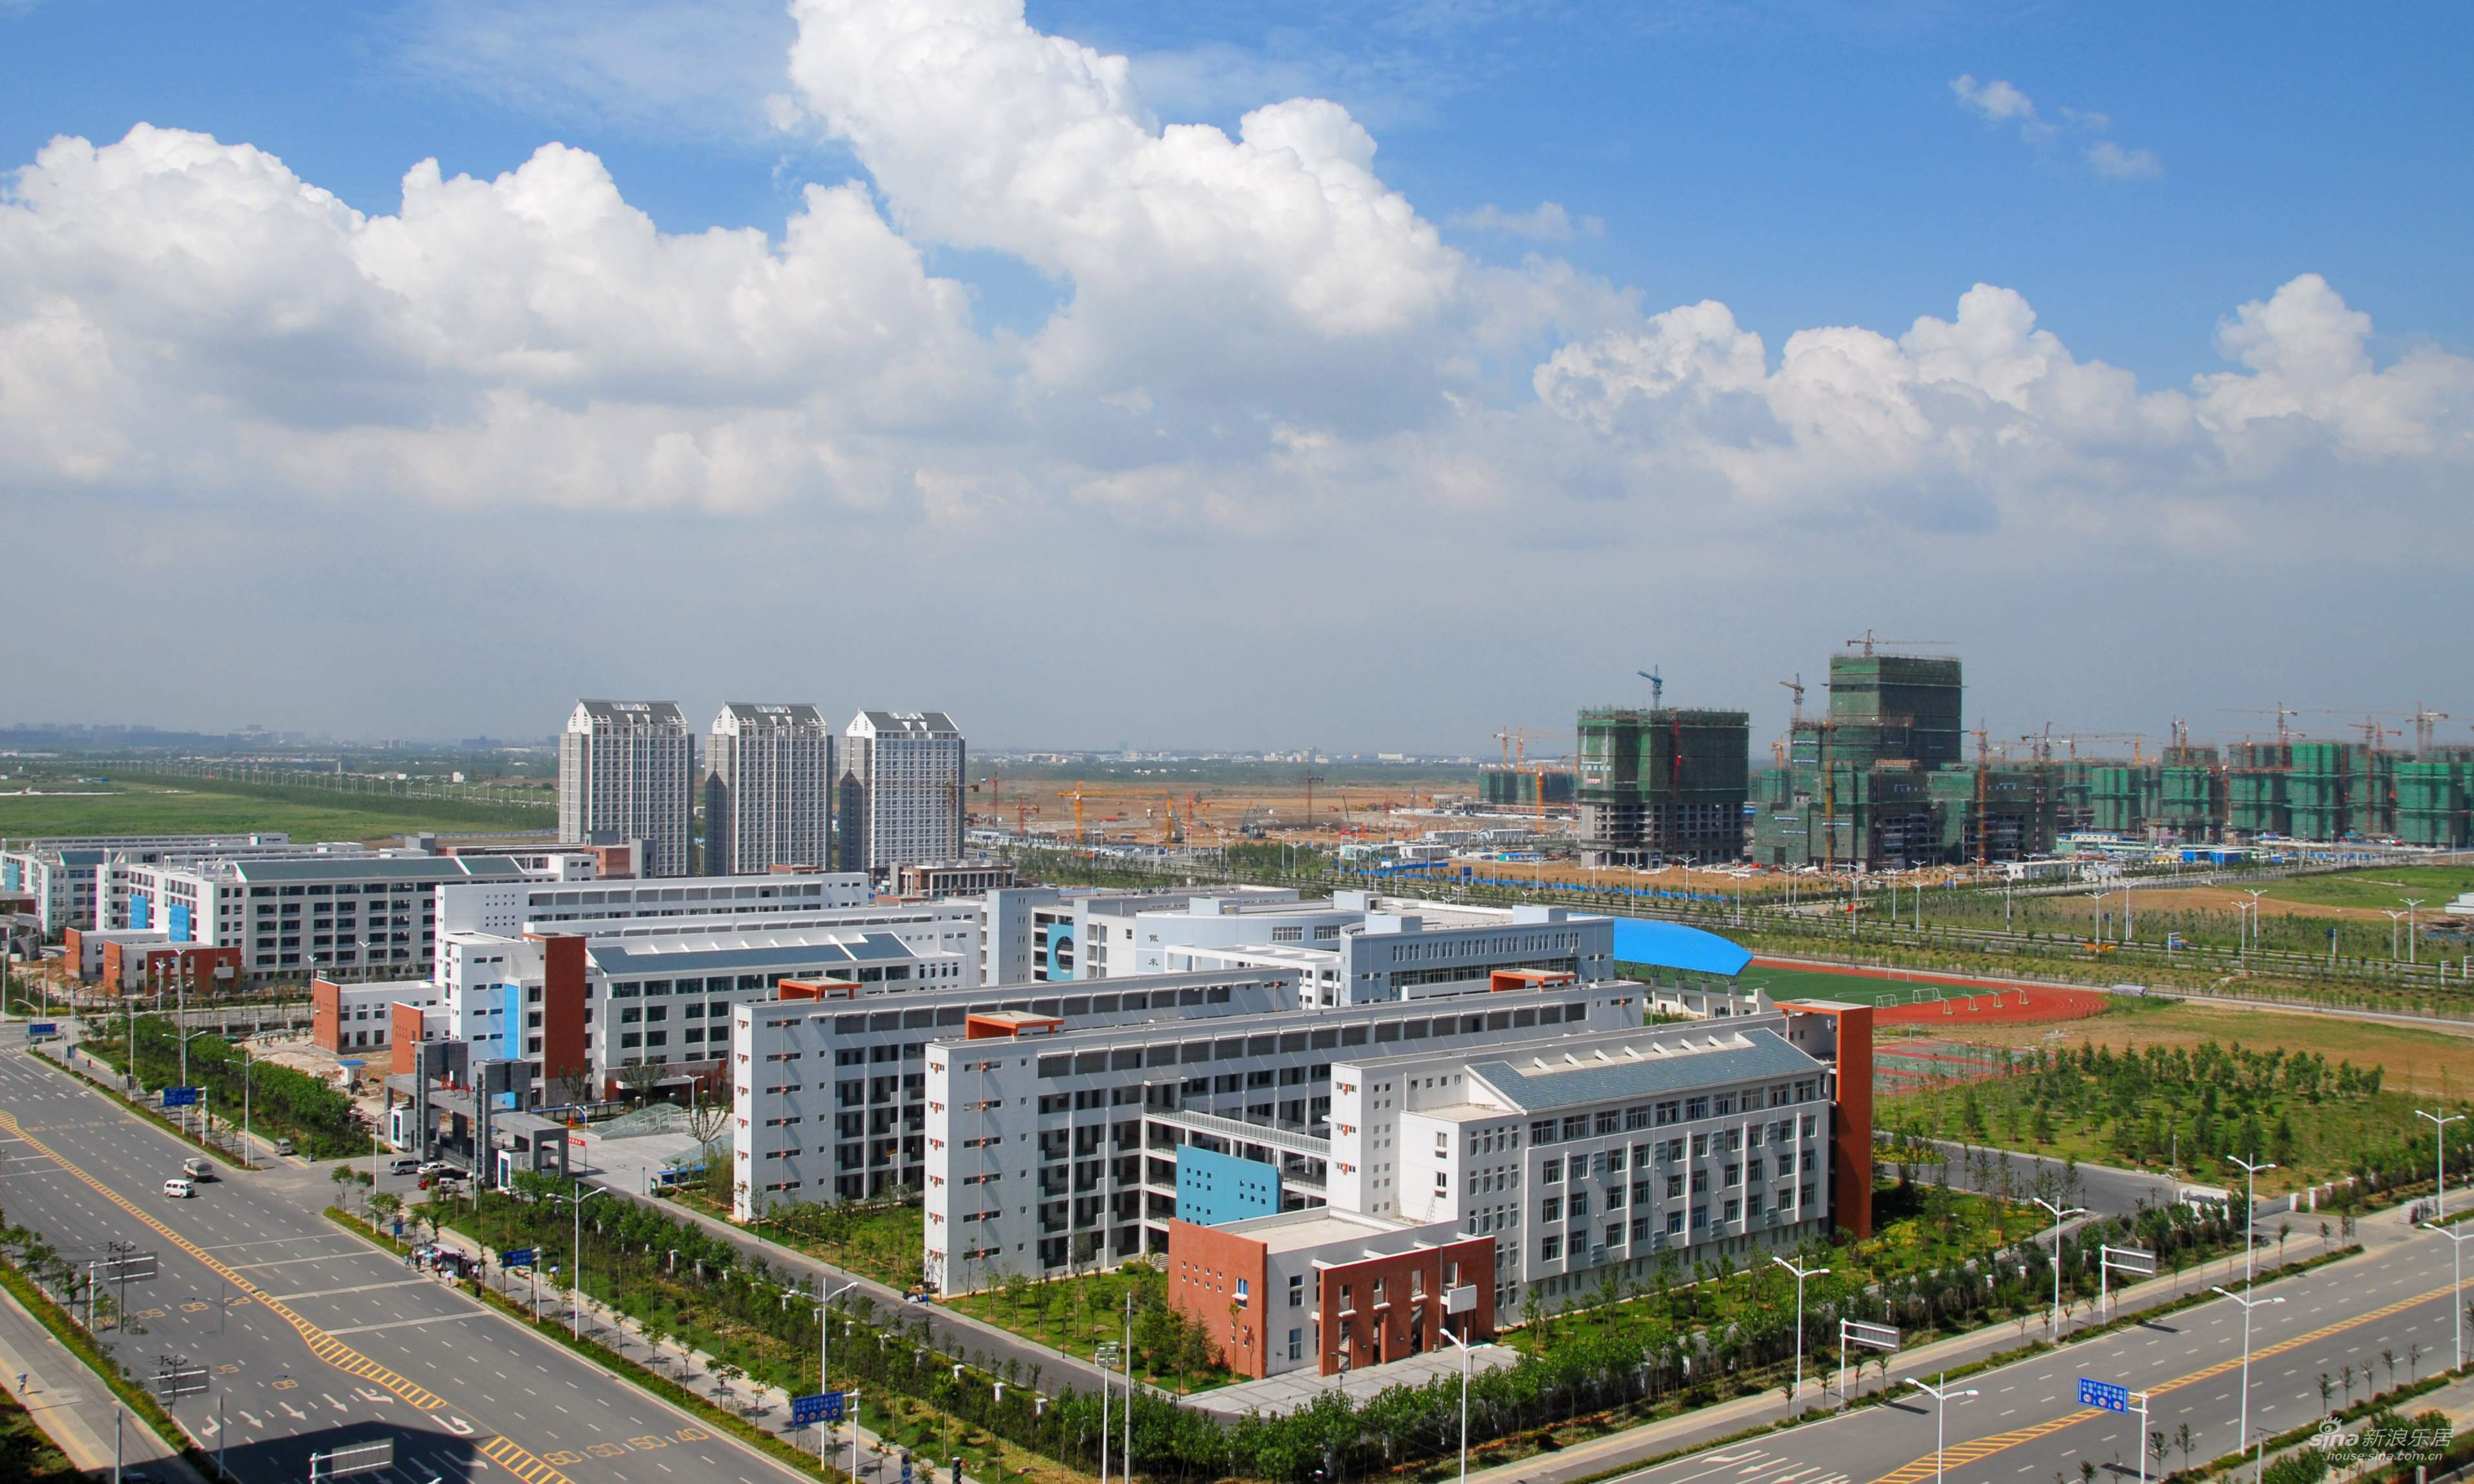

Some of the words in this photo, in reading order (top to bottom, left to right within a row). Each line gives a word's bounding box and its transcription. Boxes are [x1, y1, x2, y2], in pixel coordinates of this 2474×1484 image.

[676, 1428, 710, 1441] 40
[628, 1436, 667, 1450] 50
[543, 1450, 582, 1465] 60
